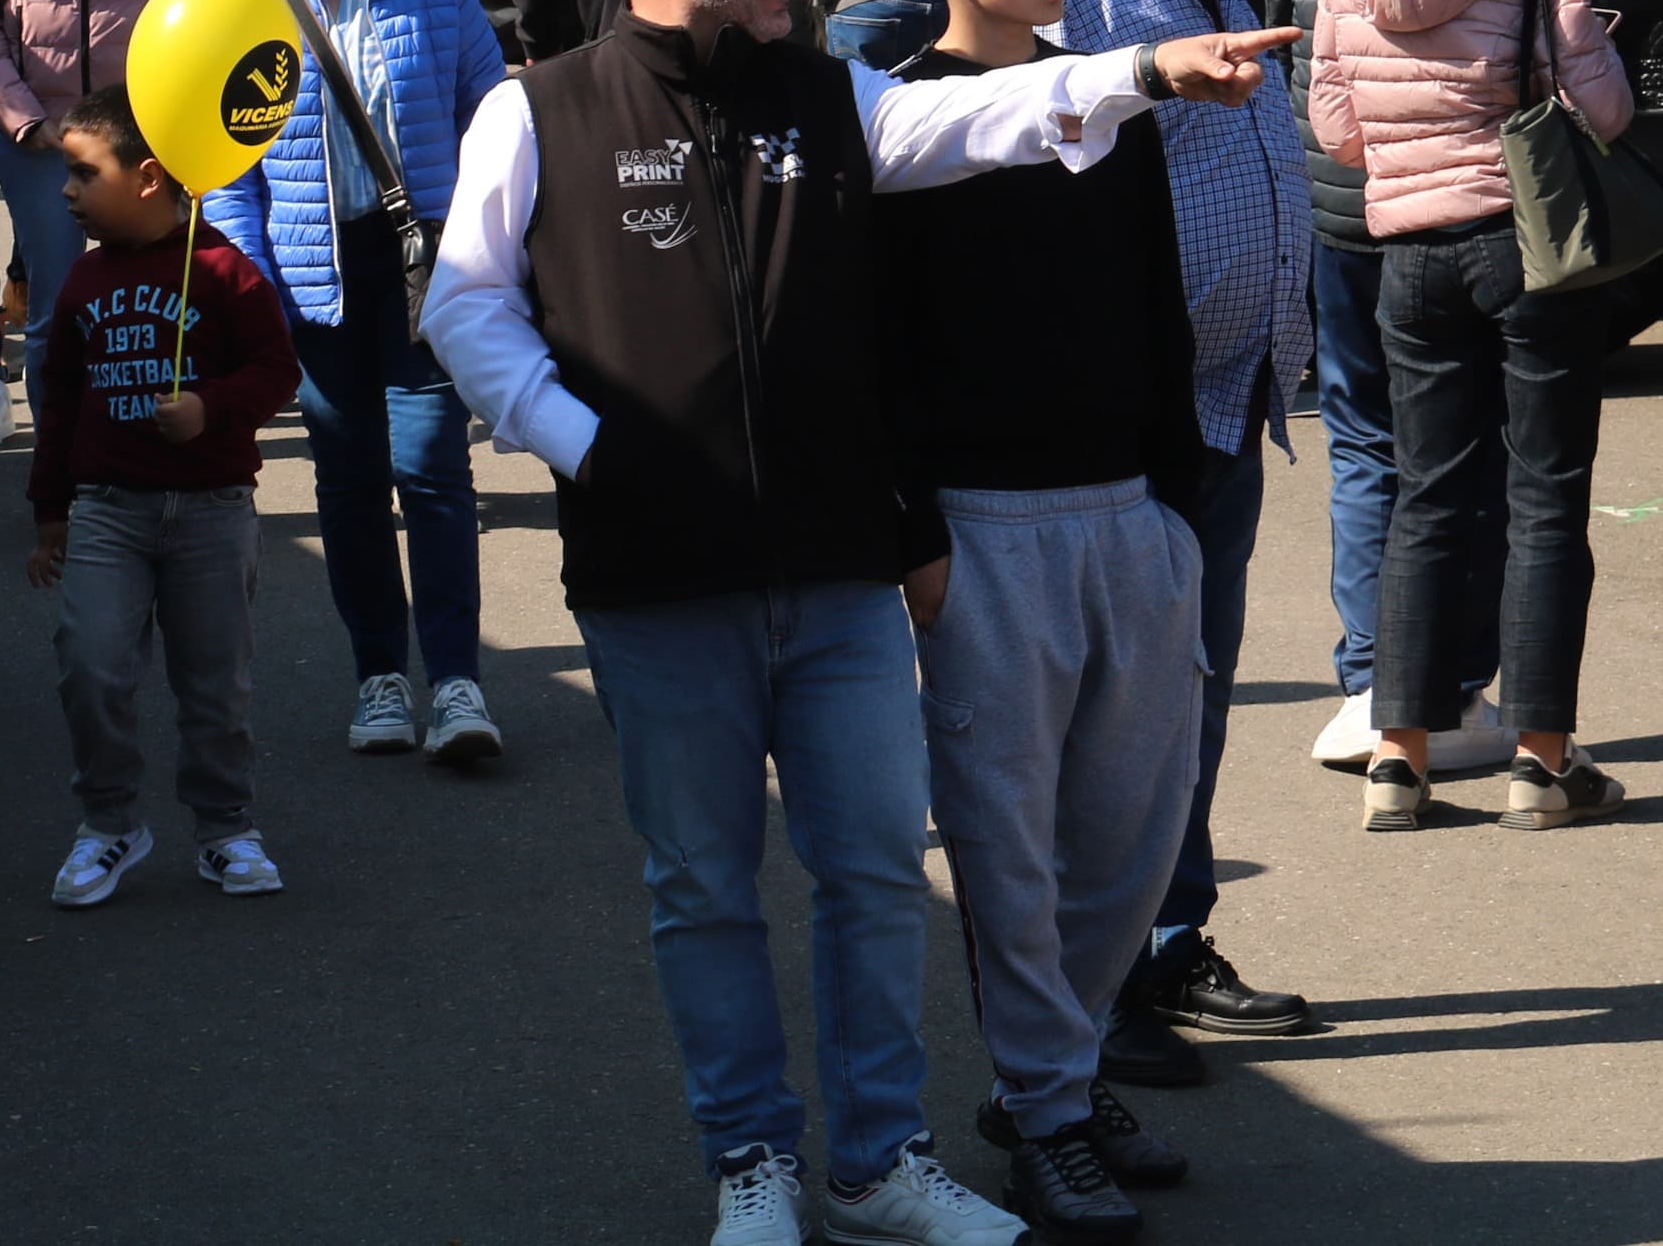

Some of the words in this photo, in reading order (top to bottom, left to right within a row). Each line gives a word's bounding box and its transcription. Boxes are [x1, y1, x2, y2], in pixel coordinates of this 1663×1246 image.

[230, 99, 295, 124] VICENS
[615, 149, 672, 166] EASY
[617, 164, 685, 183] PRINT
[622, 202, 679, 226] CASÉ
[134, 284, 202, 332] CLUB
[105, 323, 156, 354] 1973
